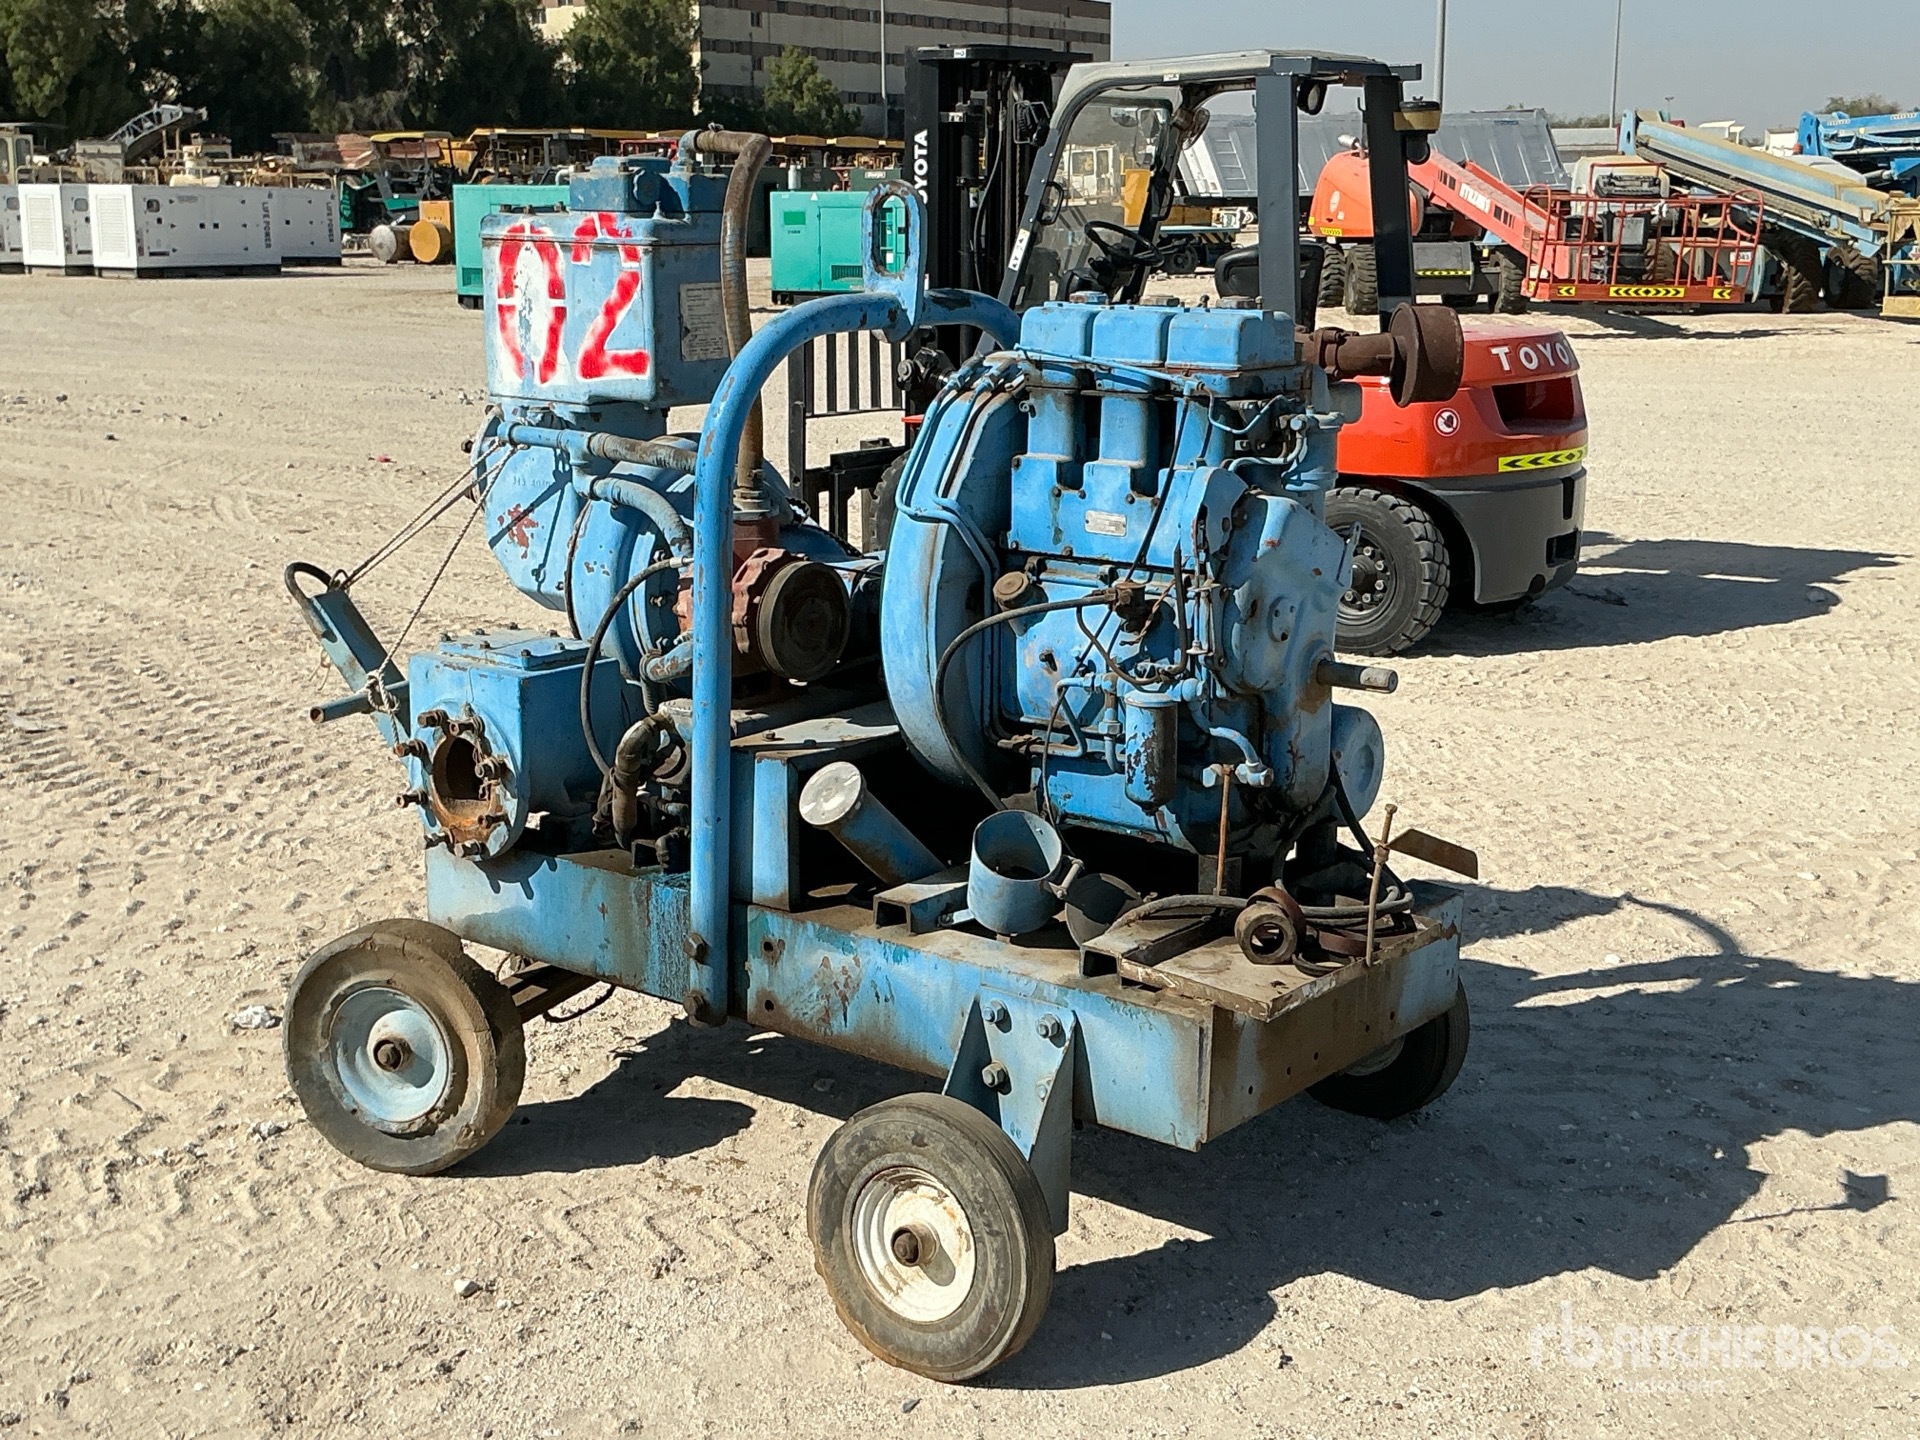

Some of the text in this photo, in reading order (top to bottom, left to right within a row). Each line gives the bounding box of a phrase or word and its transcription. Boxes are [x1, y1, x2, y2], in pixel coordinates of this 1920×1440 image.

[913, 129, 929, 205] YOTA
[497, 211, 650, 385] 02
[1490, 339, 1569, 371] TOYO
